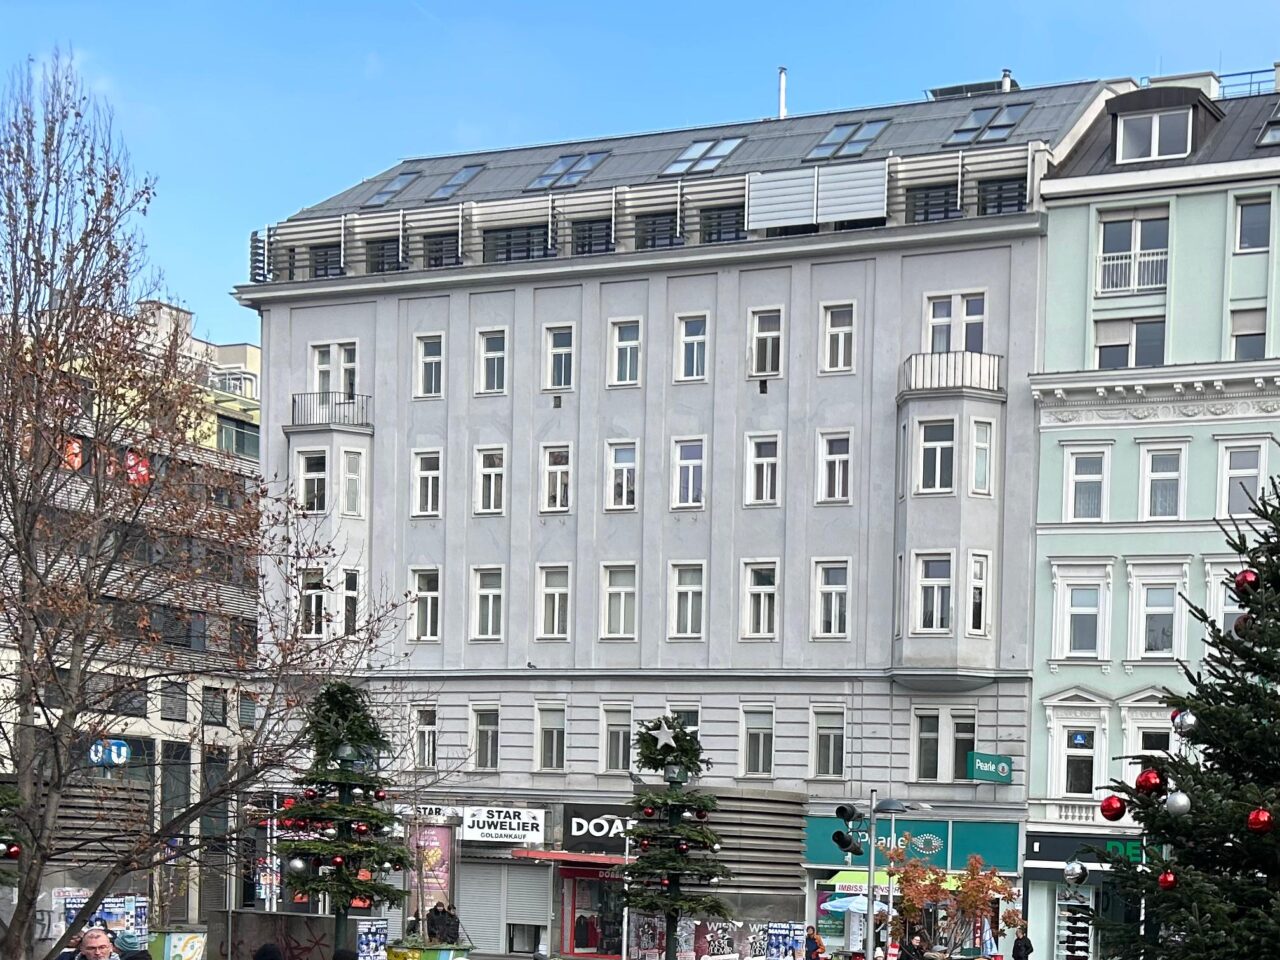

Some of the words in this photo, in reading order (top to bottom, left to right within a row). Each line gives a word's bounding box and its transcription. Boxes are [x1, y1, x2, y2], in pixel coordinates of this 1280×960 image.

[111, 745, 127, 765] U
[975, 759, 996, 772] Pearle
[486, 809, 521, 821] STAR
[467, 820, 540, 832] JUWELIER
[480, 832, 527, 840] GOLDANKAUF
[838, 884, 863, 892] IMBISS
